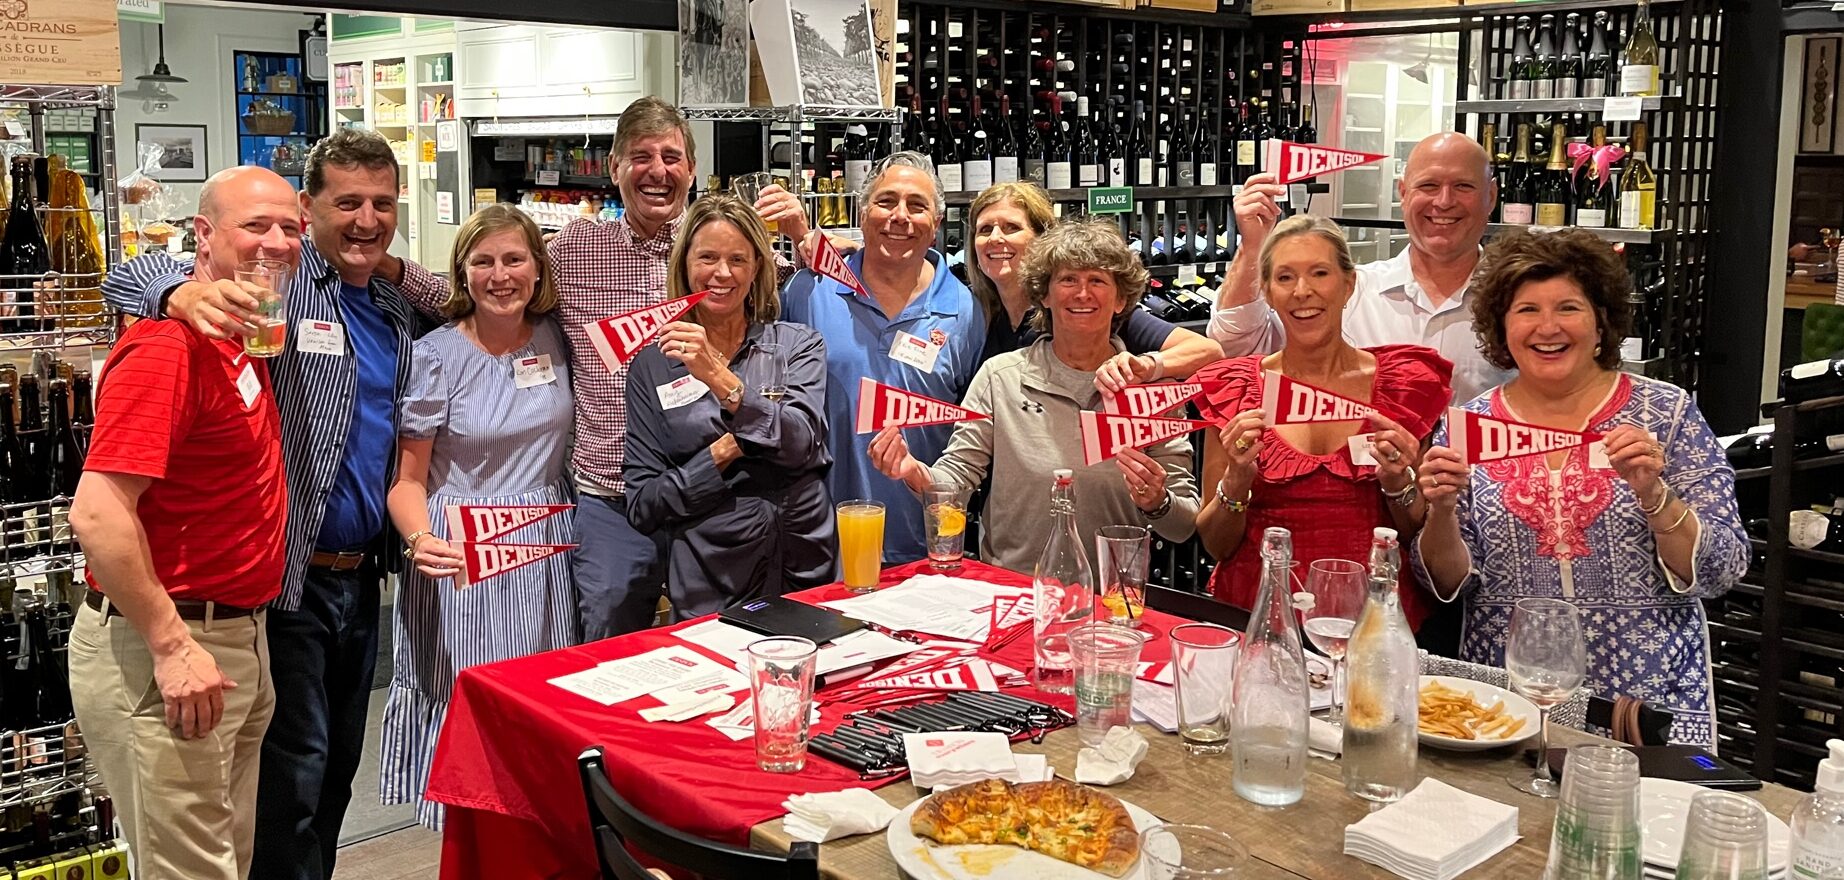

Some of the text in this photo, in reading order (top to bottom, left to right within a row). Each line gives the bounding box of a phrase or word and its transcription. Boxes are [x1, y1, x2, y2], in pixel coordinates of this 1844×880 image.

[117, 0, 149, 8] rated
[0, 43, 59, 54] SÈGUE
[1287, 145, 1365, 181] DENISON
[1095, 194, 1127, 205] FRANCE
[819, 240, 858, 290] DENISON
[608, 299, 690, 355] DENISON
[882, 388, 967, 428] DENISON
[1124, 383, 1203, 417] DENISON
[1106, 416, 1194, 455] DENISON
[1478, 418, 1583, 461] DENISON
[470, 507, 550, 542] DENISON
[475, 544, 554, 580] DENISON
[857, 666, 968, 689] DENISON
